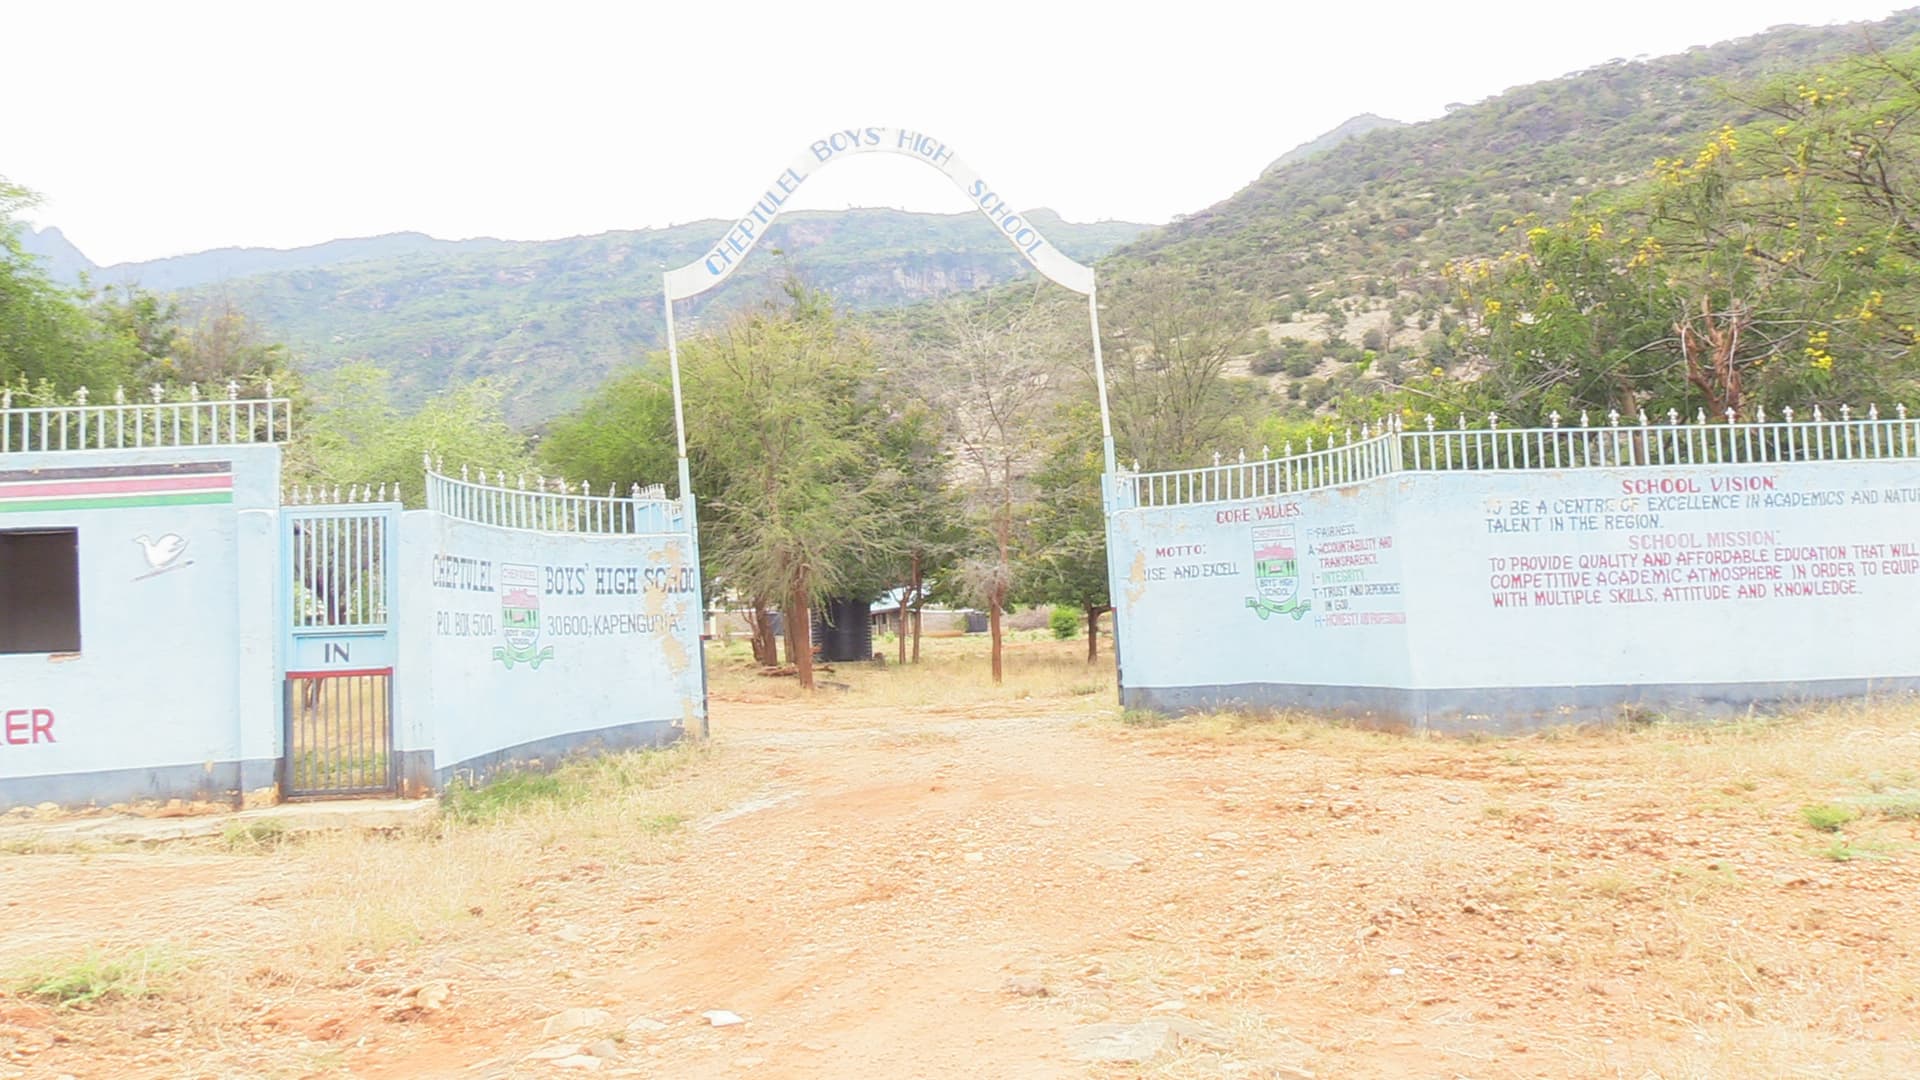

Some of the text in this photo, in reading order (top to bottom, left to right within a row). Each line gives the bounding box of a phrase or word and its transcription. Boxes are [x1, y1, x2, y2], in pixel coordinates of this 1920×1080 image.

[705, 168, 808, 275] CHEPTULEL
[898, 129, 953, 166] HIGH
[968, 180, 1042, 262] SCHOOL
[1622, 478, 1700, 495] SCHOOL
[1510, 500, 1530, 515] BE
[1536, 500, 1547, 515] A
[1553, 498, 1616, 514] CENTRE
[1621, 497, 1640, 512] OF
[1648, 494, 1740, 511] EXCELLENCE
[1746, 493, 1759, 508] IN
[1764, 490, 1844, 507] ACADEMICS
[1851, 489, 1878, 504] AND
[1884, 487, 1920, 504] NATU
[1216, 508, 1250, 524] CORE
[1486, 514, 1664, 533] TALENT IN THE REGION.
[1628, 533, 1701, 550] SCHOOL
[1489, 542, 1919, 572] TO PROVIDE QUALITY AND AFFORDABLE EDUCATION THAT WILL
[433, 554, 495, 592] CHEPTULEL
[545, 563, 589, 595] BOYS'
[595, 567, 638, 595] HIGH
[1174, 564, 1199, 579] AND
[1203, 562, 1240, 577] EXCELL
[1491, 559, 1919, 589] COMPETITIVE ACADEMIC ATMOSPHERE IN ORDER TO EQUIP
[1492, 591, 1528, 607] WITH
[1535, 588, 1601, 606] MULTIPLE
[1663, 584, 1730, 602] ATTITUDE
[1737, 583, 1767, 599] AND
[1773, 580, 1863, 597] KNOWLEDGE.
[455, 611, 471, 636] BOX
[325, 643, 349, 663] IN
[0, 709, 56, 745] ER
